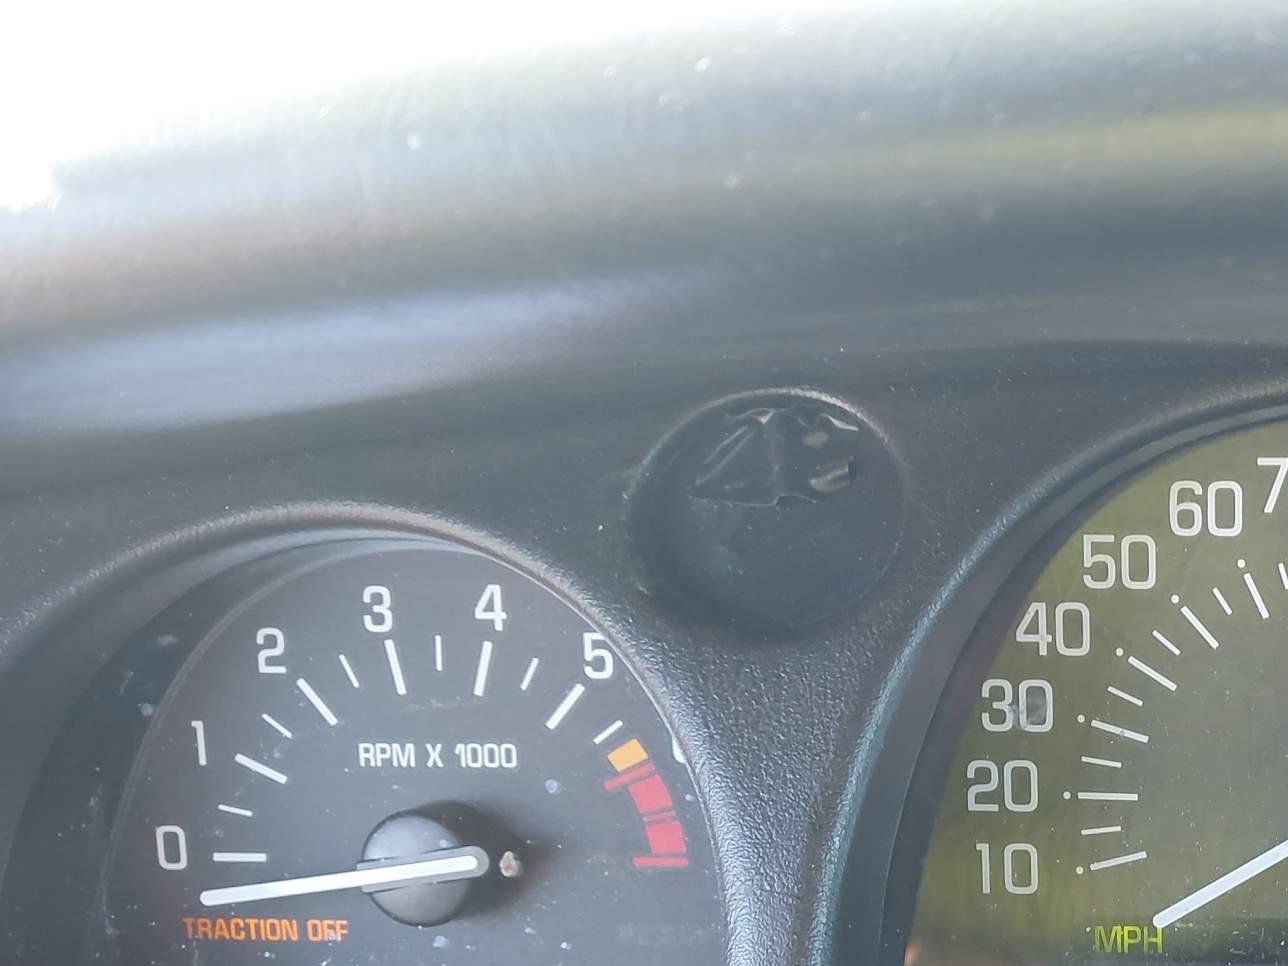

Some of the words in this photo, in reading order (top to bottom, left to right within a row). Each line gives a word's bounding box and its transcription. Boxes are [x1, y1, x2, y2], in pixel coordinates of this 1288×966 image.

[1168, 480, 1243, 537] 60
[1082, 534, 1158, 590] 50
[362, 586, 393, 633] 3
[475, 584, 507, 631] 4
[1015, 602, 1091, 657] 40
[256, 628, 287, 674] 2
[582, 632, 614, 680] 5
[981, 679, 1054, 733] 30
[191, 720, 208, 766] 1
[358, 743, 416, 768] RPM
[426, 743, 442, 768] X
[455, 743, 518, 769] 1000
[966, 760, 1040, 814] 20
[155, 825, 188, 871] 0
[975, 843, 1039, 896] 10
[183, 918, 299, 942] TRACTION
[306, 919, 349, 942] OFF
[1093, 926, 1164, 955] MPH
